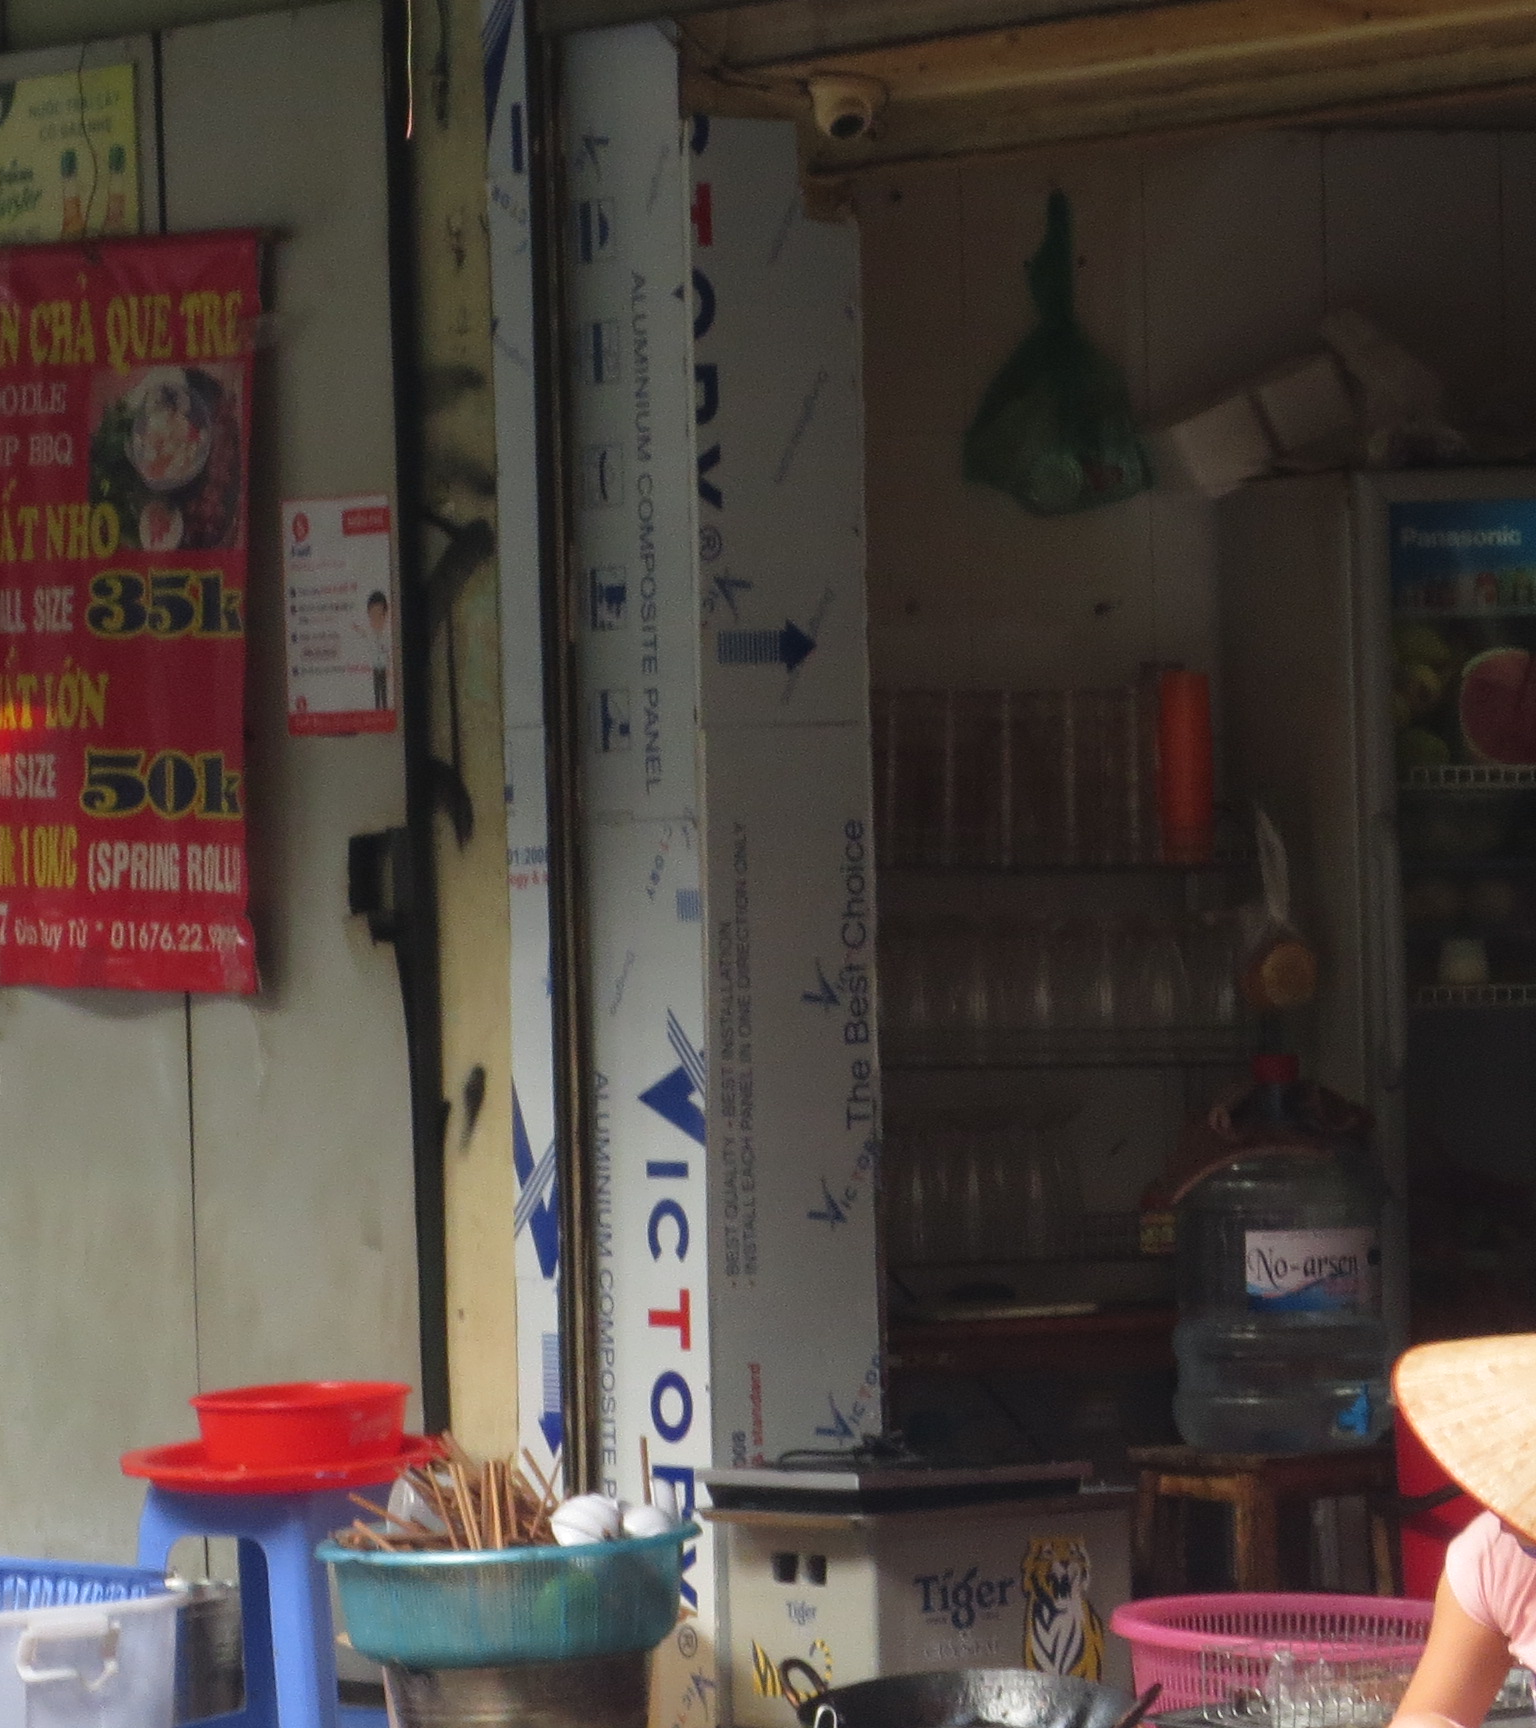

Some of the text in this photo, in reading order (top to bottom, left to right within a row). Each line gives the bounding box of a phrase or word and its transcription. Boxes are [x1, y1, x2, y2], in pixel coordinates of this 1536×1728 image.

[630, 270, 664, 796] ALUMINIUM COMPOSITE PANEL
[33, 585, 75, 634] SIZE
[842, 818, 866, 949] Choice
[846, 1059, 874, 1131] The
[598, 1269, 618, 1466] COMPOSITE
[914, 1567, 1014, 1629] Tiger
